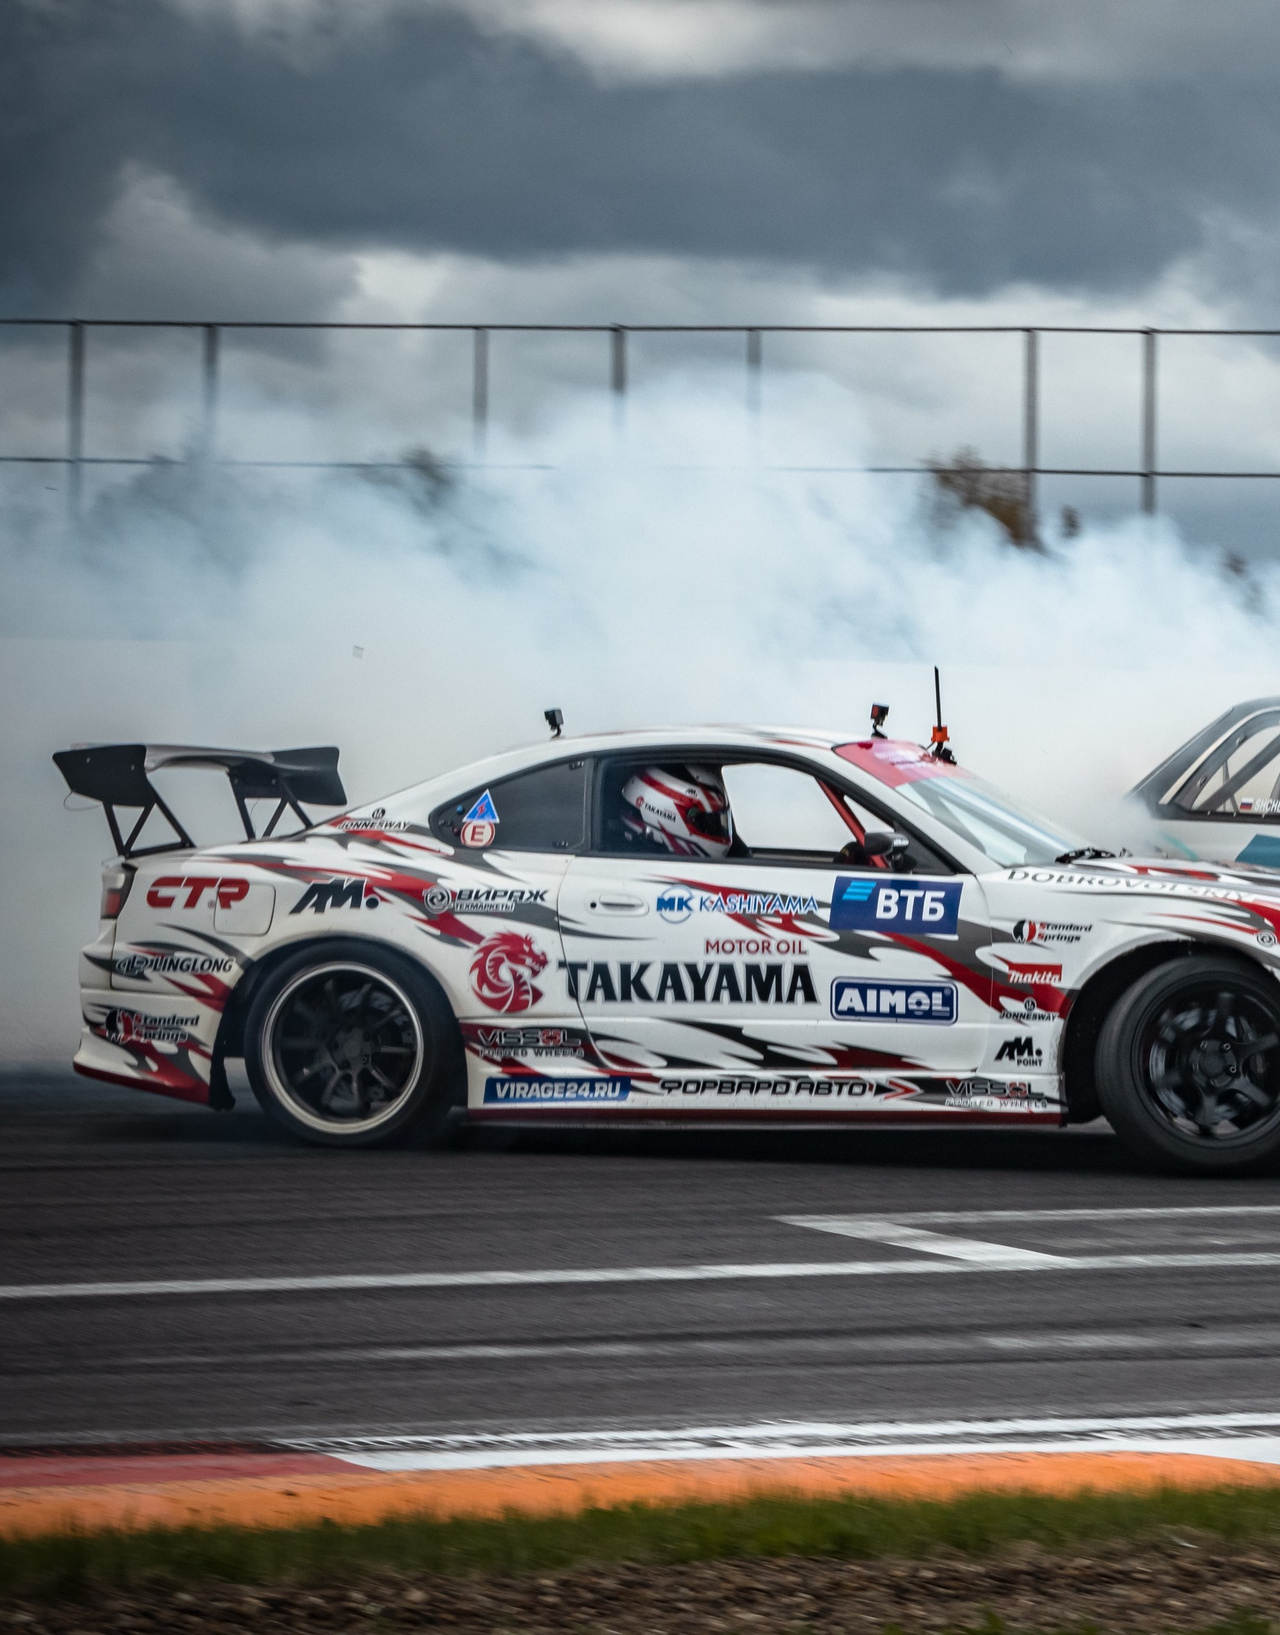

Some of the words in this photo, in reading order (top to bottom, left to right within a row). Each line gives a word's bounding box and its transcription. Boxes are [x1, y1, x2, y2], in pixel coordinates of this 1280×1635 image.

[470, 825, 486, 843] E
[146, 876, 250, 910] CTR
[456, 888, 549, 903] ВИРАЖ
[699, 892, 819, 914] KASHIYAMA
[875, 888, 946, 922] ВТБ
[705, 939, 771, 955] MOTOR
[776, 939, 808, 955] OIL
[152, 954, 236, 973] LINGLONG
[558, 961, 819, 1003] TAKAYAMA
[837, 987, 950, 1016] AIMOL
[478, 1028, 582, 1047] VISSOL
[1017, 1059, 1043, 1067] POINT
[495, 1081, 622, 1100] VIRAGE24.RU
[795, 1079, 868, 1096] АВТО
[945, 1080, 1045, 1098] VISSOL
